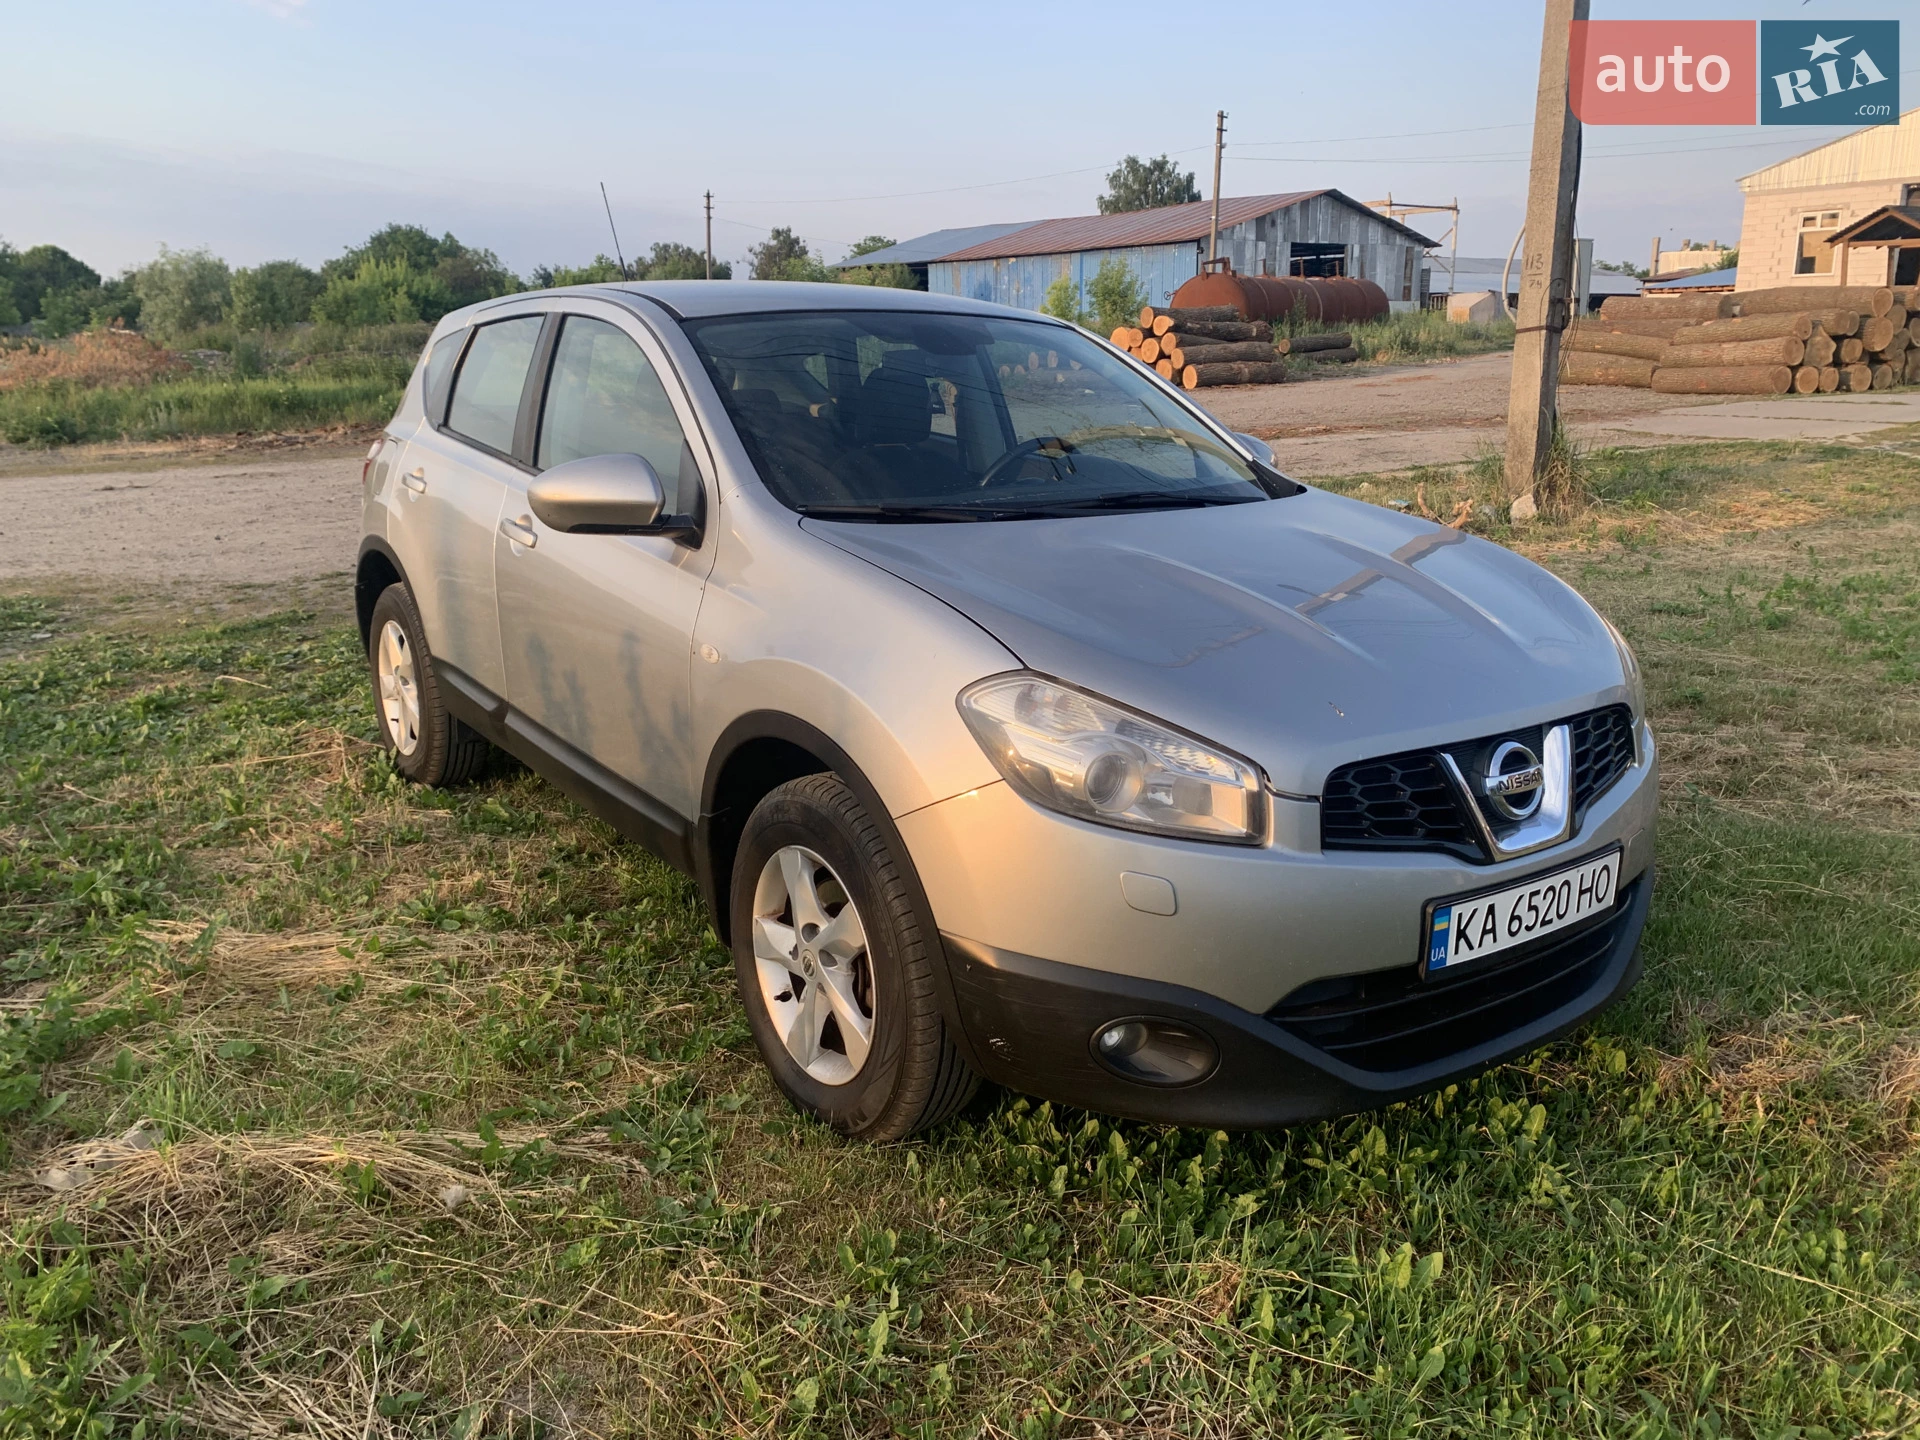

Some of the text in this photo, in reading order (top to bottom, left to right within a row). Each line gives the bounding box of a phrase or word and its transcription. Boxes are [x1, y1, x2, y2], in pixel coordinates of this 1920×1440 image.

[1498, 768, 1543, 791] NISSAN
[1454, 864, 1611, 955] KA 6520 HO
[1431, 946, 1446, 962] UA
